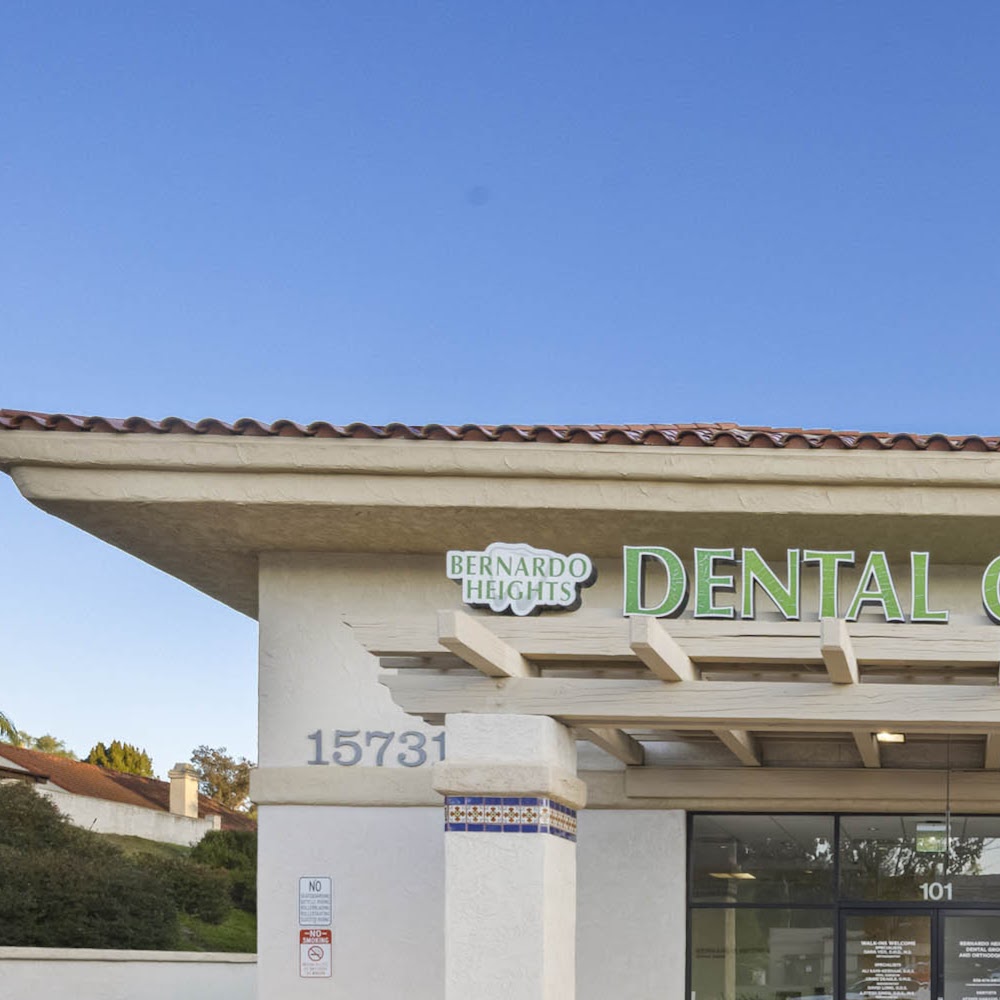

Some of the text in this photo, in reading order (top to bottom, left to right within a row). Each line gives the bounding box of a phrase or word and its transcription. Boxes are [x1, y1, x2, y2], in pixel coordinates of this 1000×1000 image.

[451, 555, 587, 578] BERNARDO
[467, 579, 572, 602] HEIGHTS
[622, 545, 949, 622] DENTAL
[307, 729, 446, 767] 15731
[309, 881, 321, 892] NO
[919, 882, 953, 901] 101
[309, 930, 322, 938] NO
